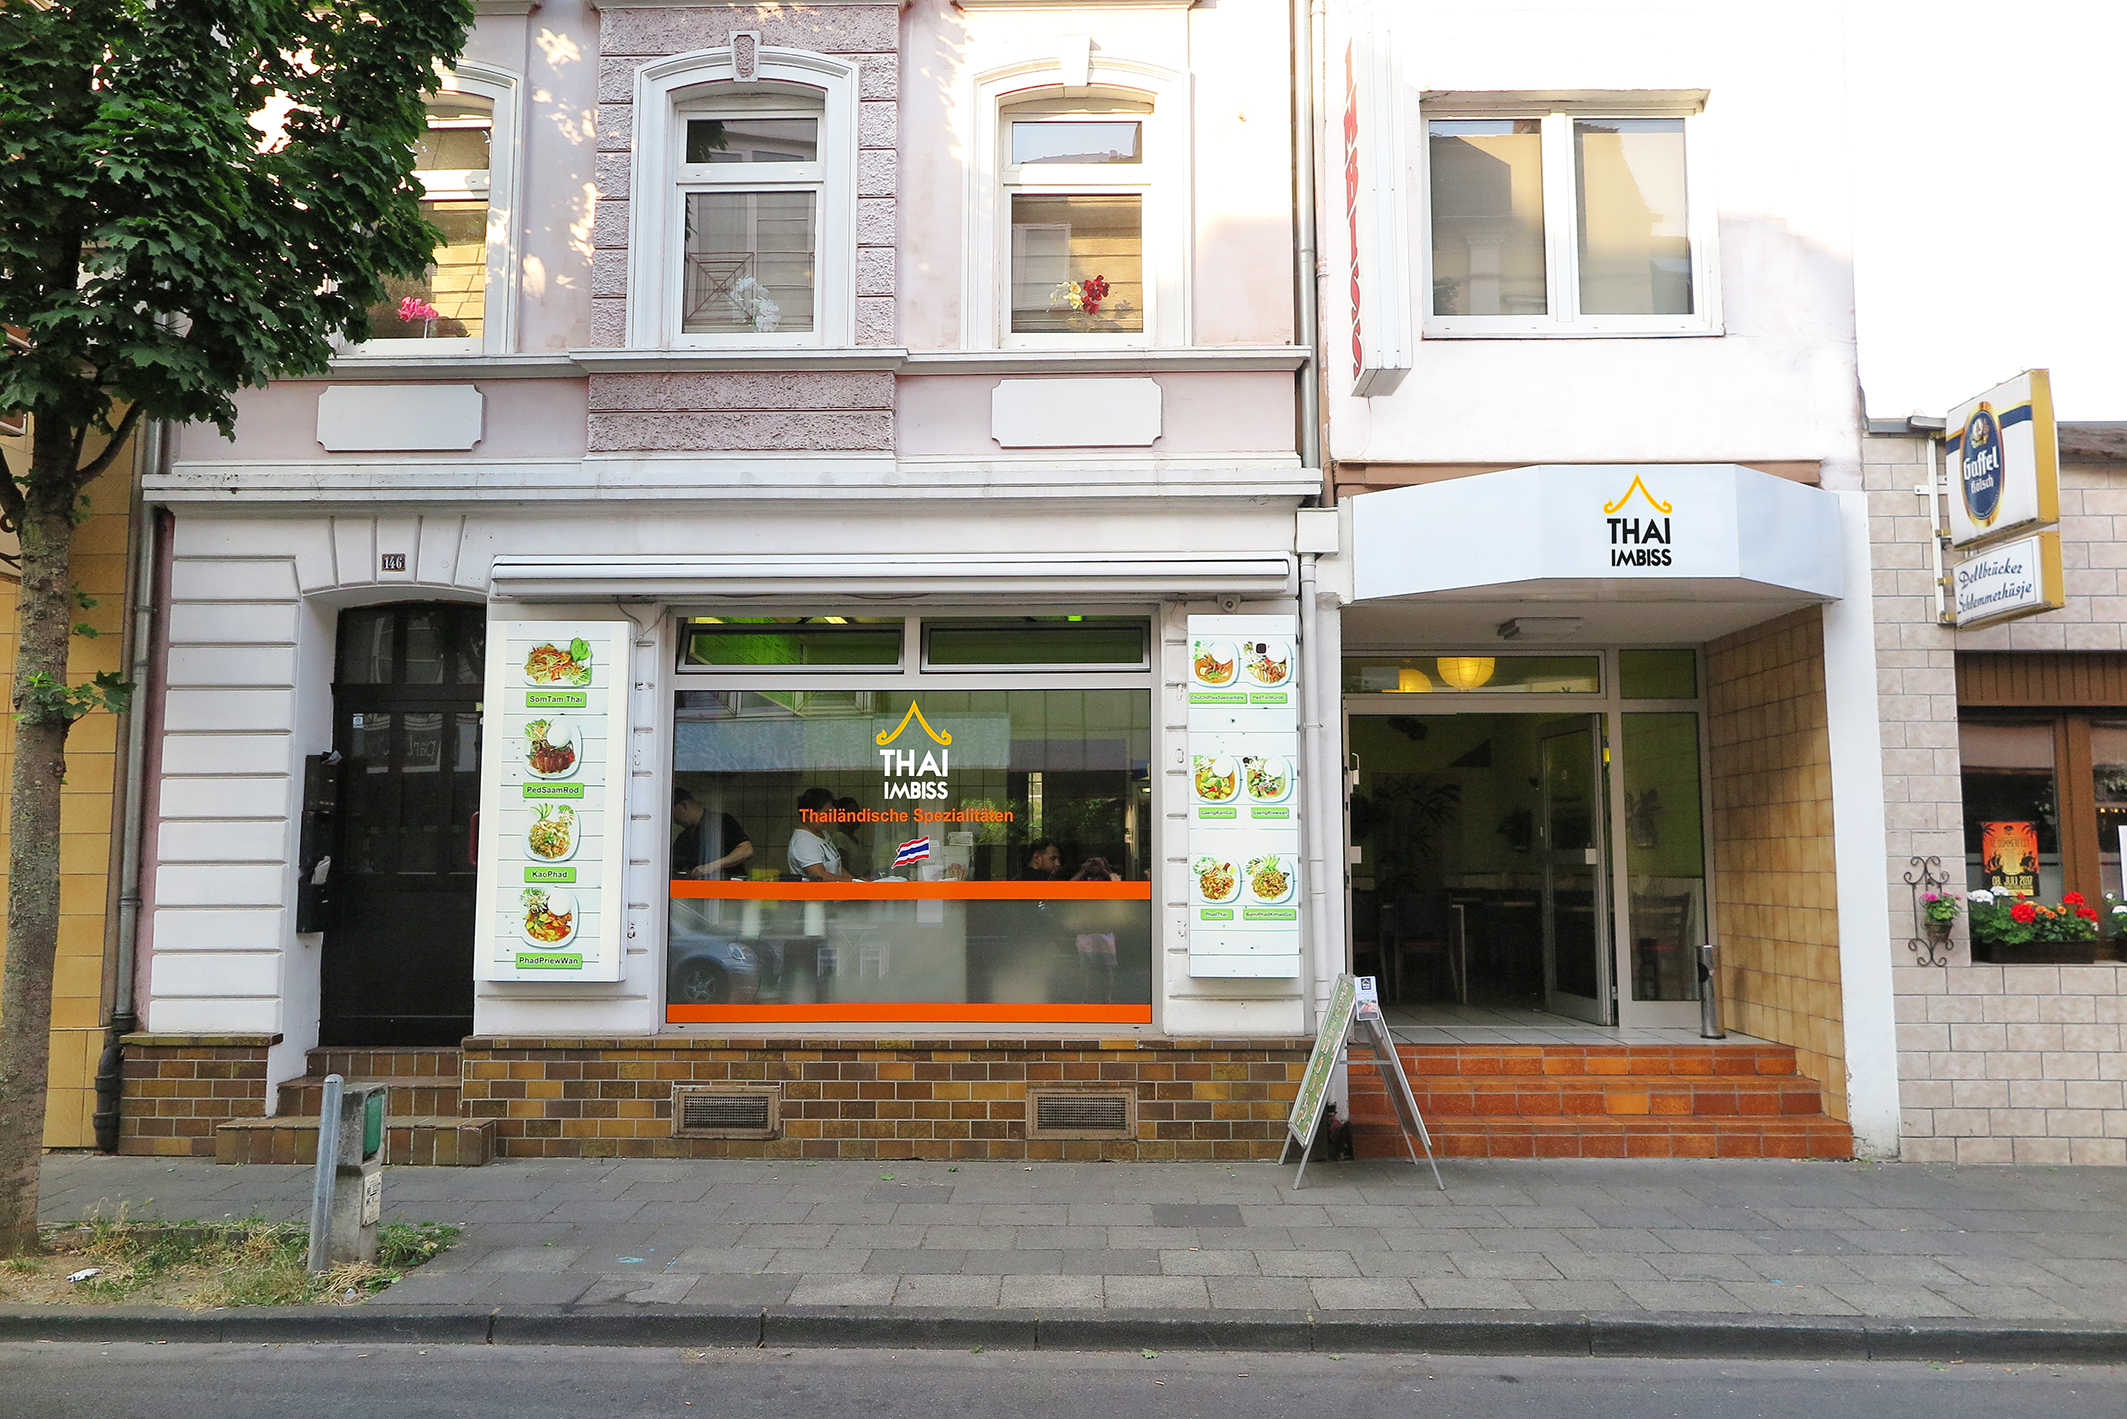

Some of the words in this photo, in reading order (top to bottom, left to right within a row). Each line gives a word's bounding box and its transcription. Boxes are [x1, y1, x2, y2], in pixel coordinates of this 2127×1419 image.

[1344, 37, 1362, 382] IMBISS
[1963, 446, 2000, 481] Gaffel
[1606, 517, 1672, 545] THAI
[384, 556, 403, 569] 146
[1611, 548, 1672, 567] IMBISS
[1958, 557, 2023, 590] Dellbrücker
[1957, 580, 2033, 615] Schlemmerhüsje
[529, 695, 564, 703] SomTam
[566, 695, 583, 703] Thai
[879, 748, 949, 777] THAI
[526, 786, 579, 795] PedSaamRod
[884, 780, 949, 800] IMBISS
[799, 808, 909, 823] Thailändische
[913, 808, 1014, 825] Spezialitäten
[532, 870, 568, 879] KaoPhad
[519, 956, 579, 966] PhadPriewWan
